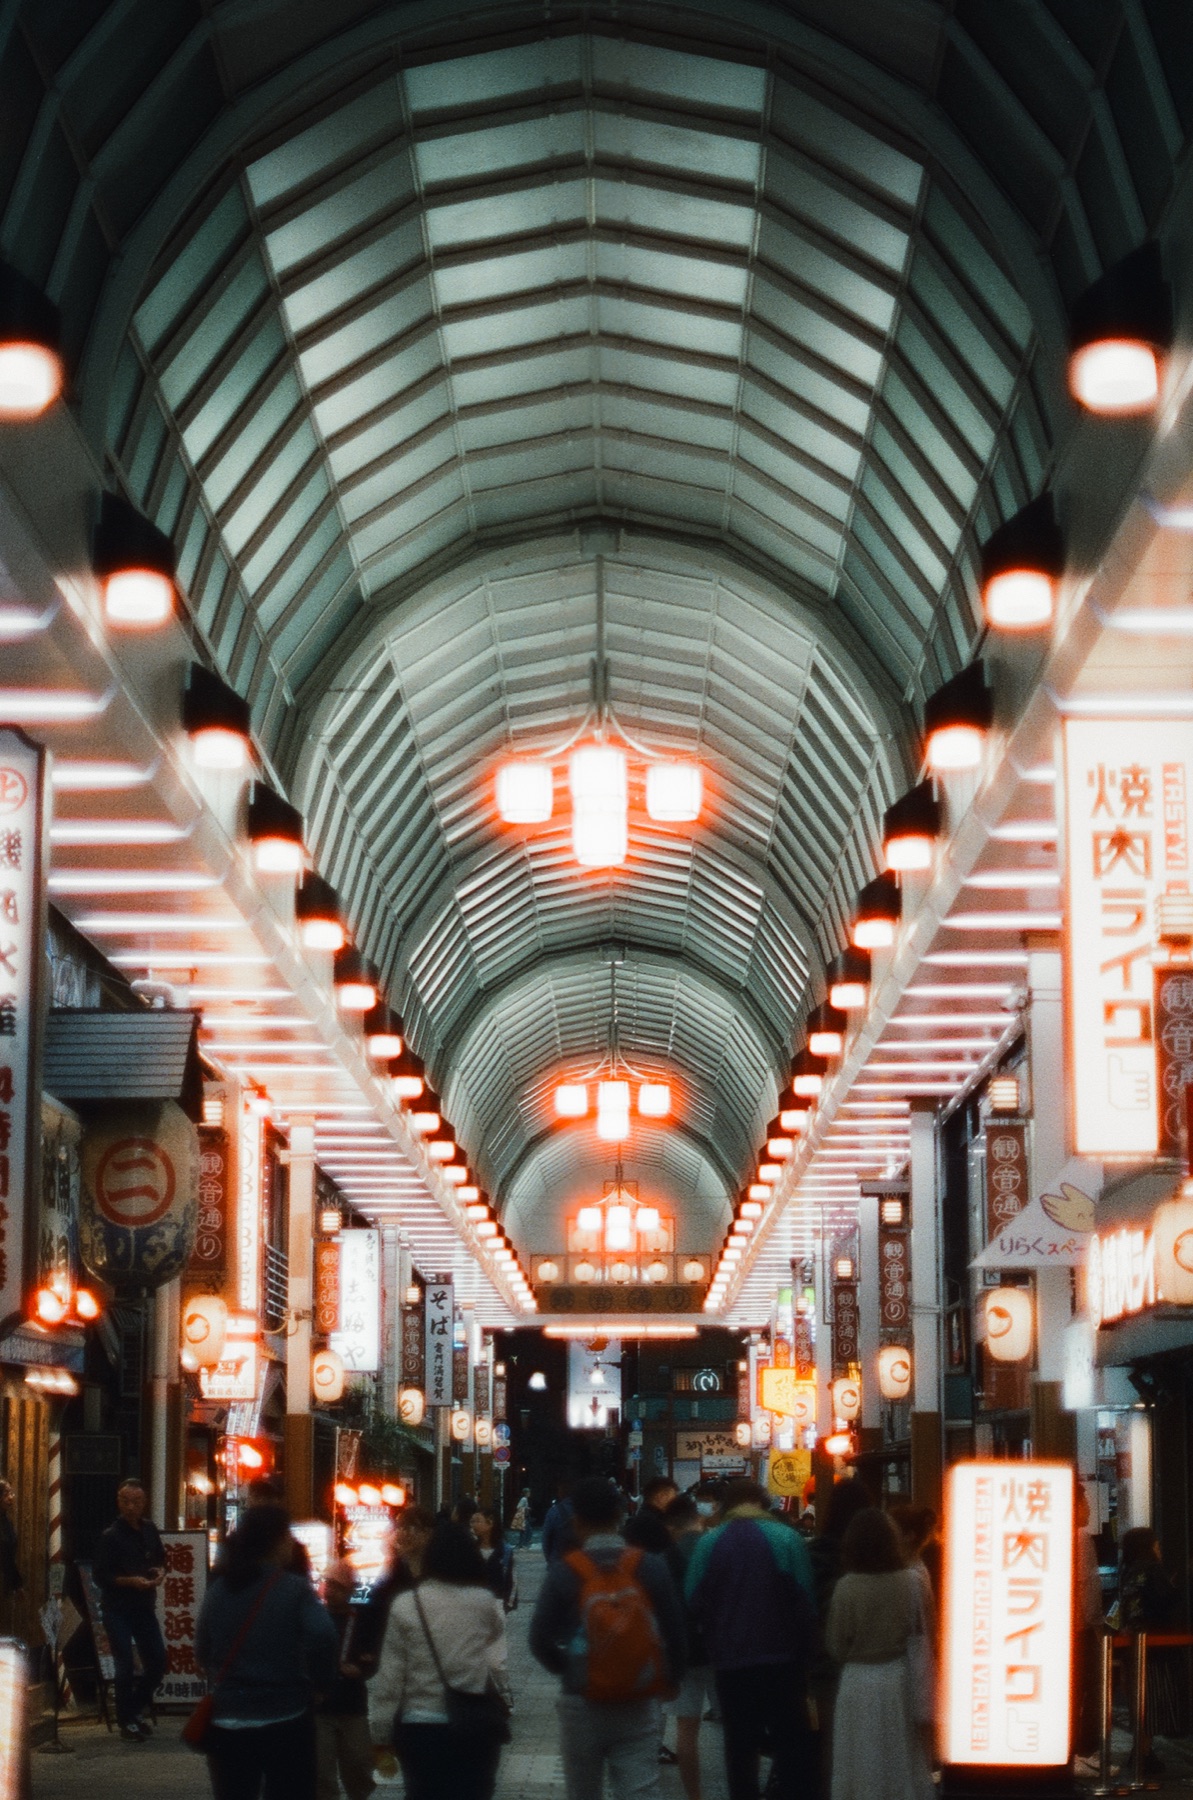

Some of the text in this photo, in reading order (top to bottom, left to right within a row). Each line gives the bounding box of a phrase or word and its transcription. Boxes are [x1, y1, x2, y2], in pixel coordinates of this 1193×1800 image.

[1162, 762, 1189, 871] TASTY!
[1087, 762, 1153, 1048] 焼肉ライク
[196, 1152, 224, 1260] 観音通り
[991, 1135, 1021, 1237] 観音通
[430, 1290, 450, 1336] そば
[838, 1290, 856, 1357] 観音通り
[884, 1240, 904, 1321] 観音通り
[405, 1315, 420, 1372] 観音通り
[164, 1543, 197, 1676] 海鮮浜焼
[1001, 1478, 1050, 1703] 焼肉ライク
